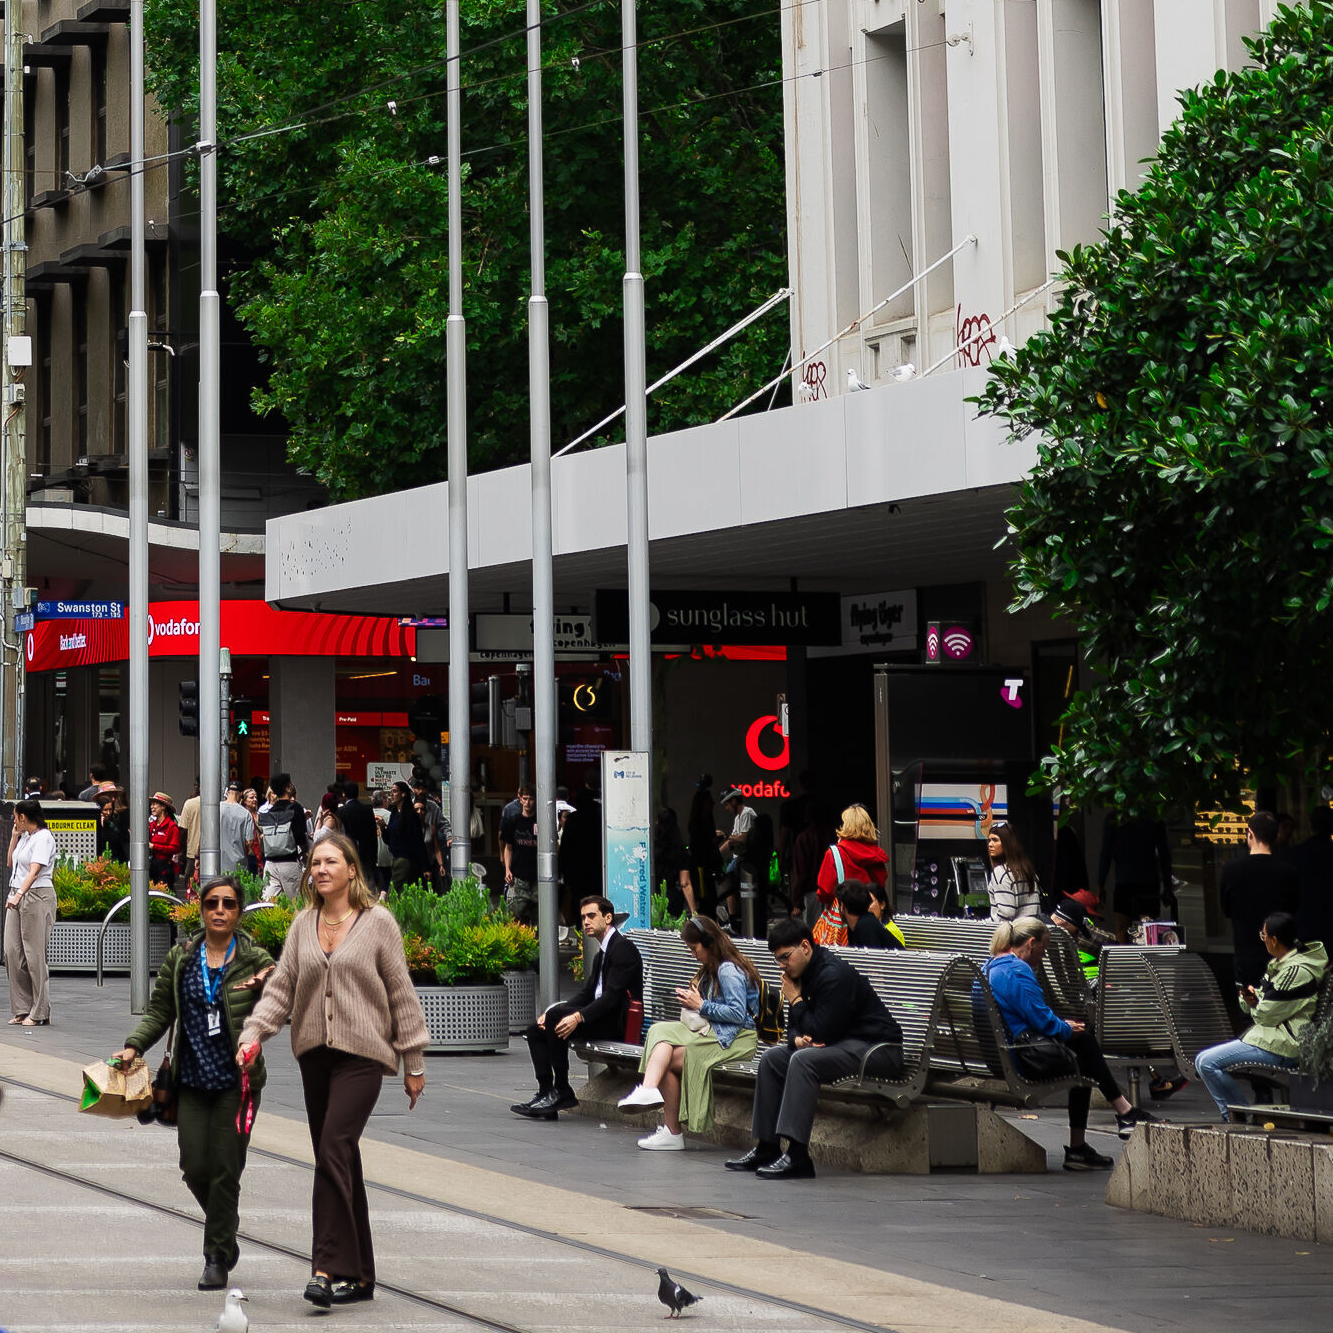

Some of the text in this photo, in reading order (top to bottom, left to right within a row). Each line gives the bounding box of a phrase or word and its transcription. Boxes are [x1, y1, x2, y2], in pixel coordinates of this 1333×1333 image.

[57, 602, 121, 613] Swanston St
[667, 602, 809, 632] sunglass hut
[76, 821, 95, 830] CLEAN
[639, 884, 647, 917] Water
